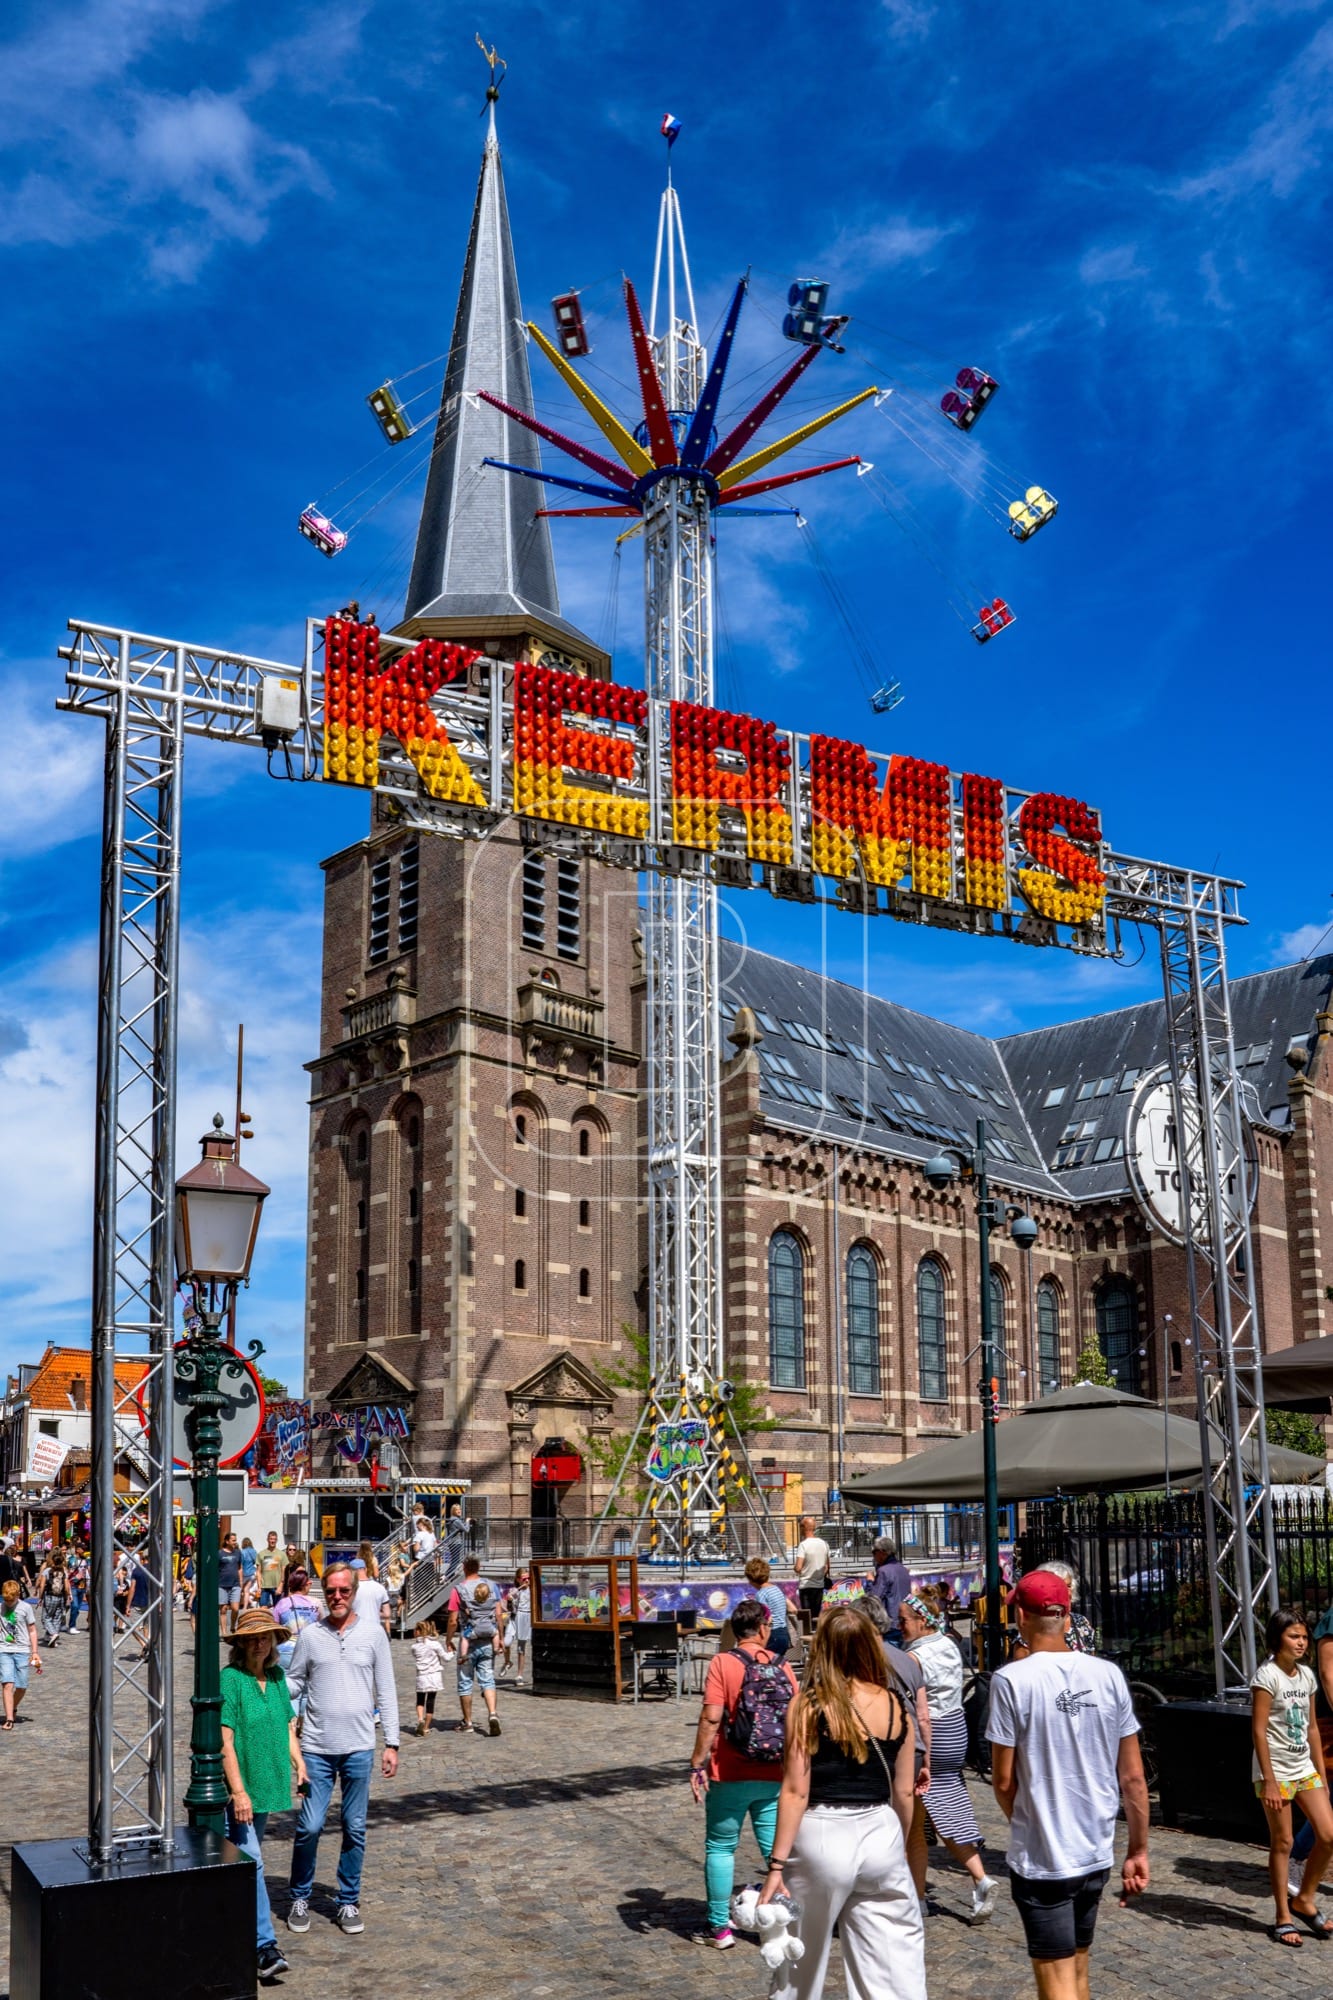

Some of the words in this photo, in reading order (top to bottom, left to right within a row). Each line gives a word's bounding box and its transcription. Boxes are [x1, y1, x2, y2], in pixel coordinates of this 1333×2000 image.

[323, 617, 1107, 924] KERMIS
[278, 1418, 300, 1446] KOP
[287, 1433, 305, 1458] JUT
[311, 1411, 356, 1430] SPACE
[336, 1406, 410, 1463] JAM
